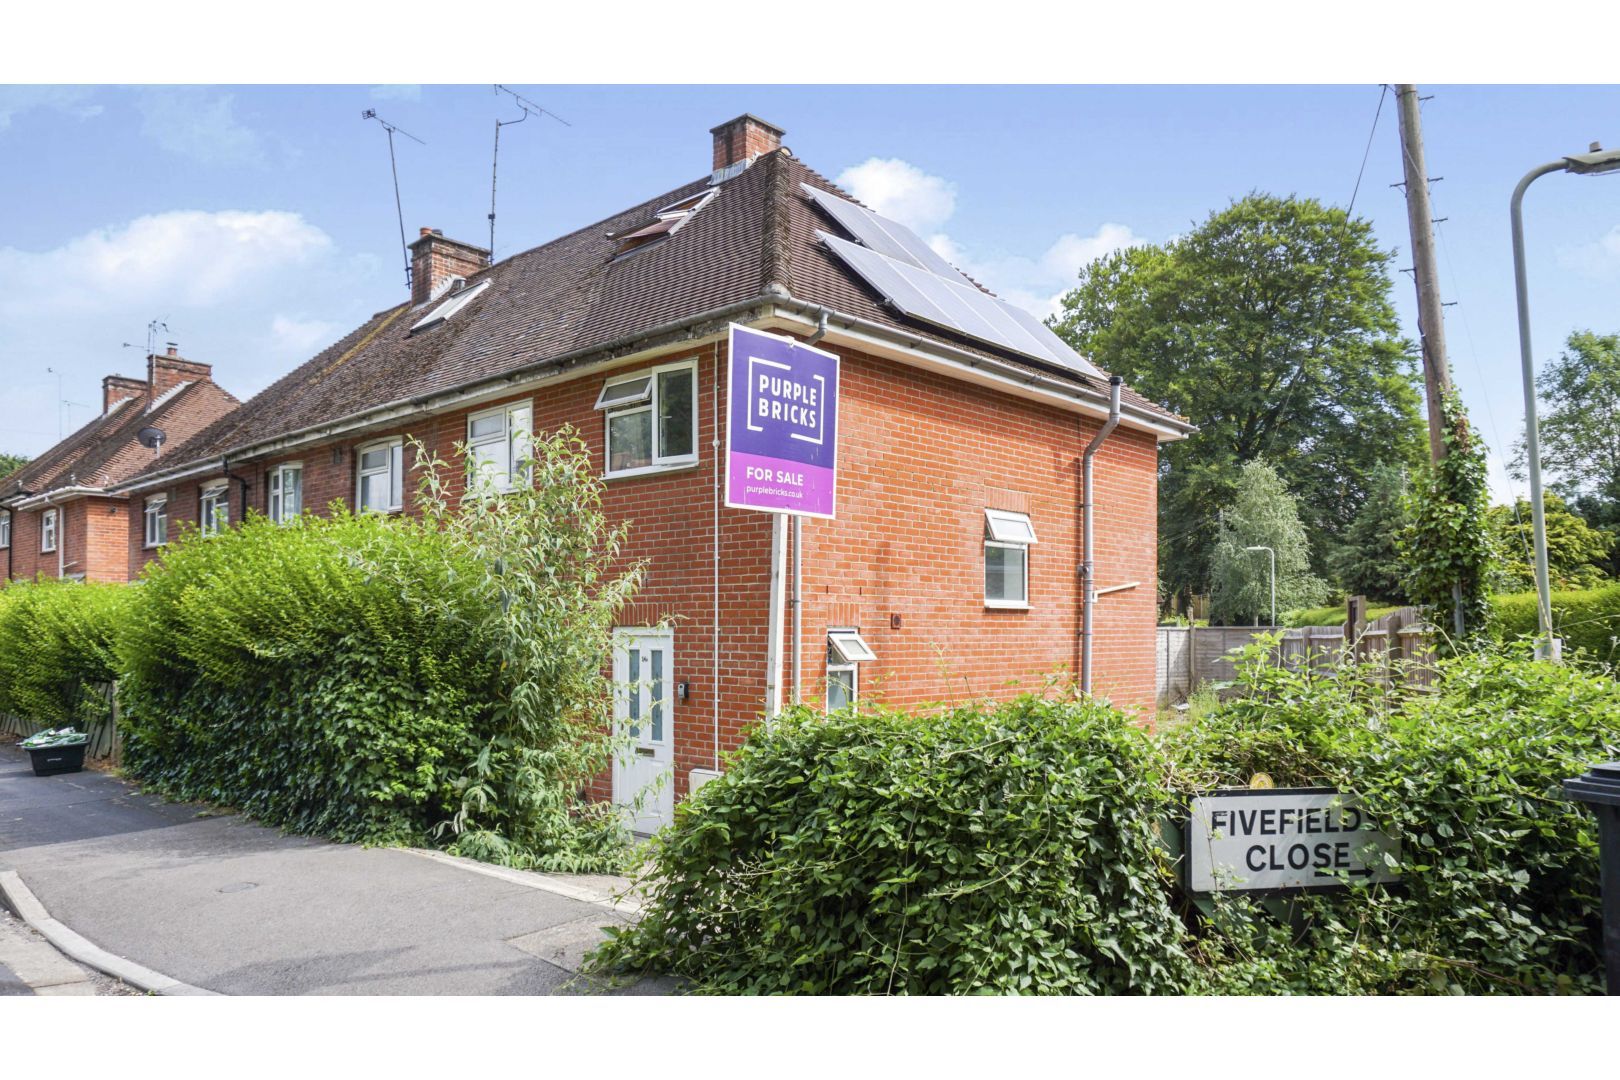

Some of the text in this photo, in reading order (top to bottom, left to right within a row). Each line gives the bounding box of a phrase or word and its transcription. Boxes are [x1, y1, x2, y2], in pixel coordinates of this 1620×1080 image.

[759, 374, 817, 406] PURPLE
[758, 397, 816, 428] BRICKS
[746, 466, 804, 487] FOR SALE
[746, 486, 804, 499] purplebricks.co.uk
[1246, 842, 1350, 872] CLOSE
